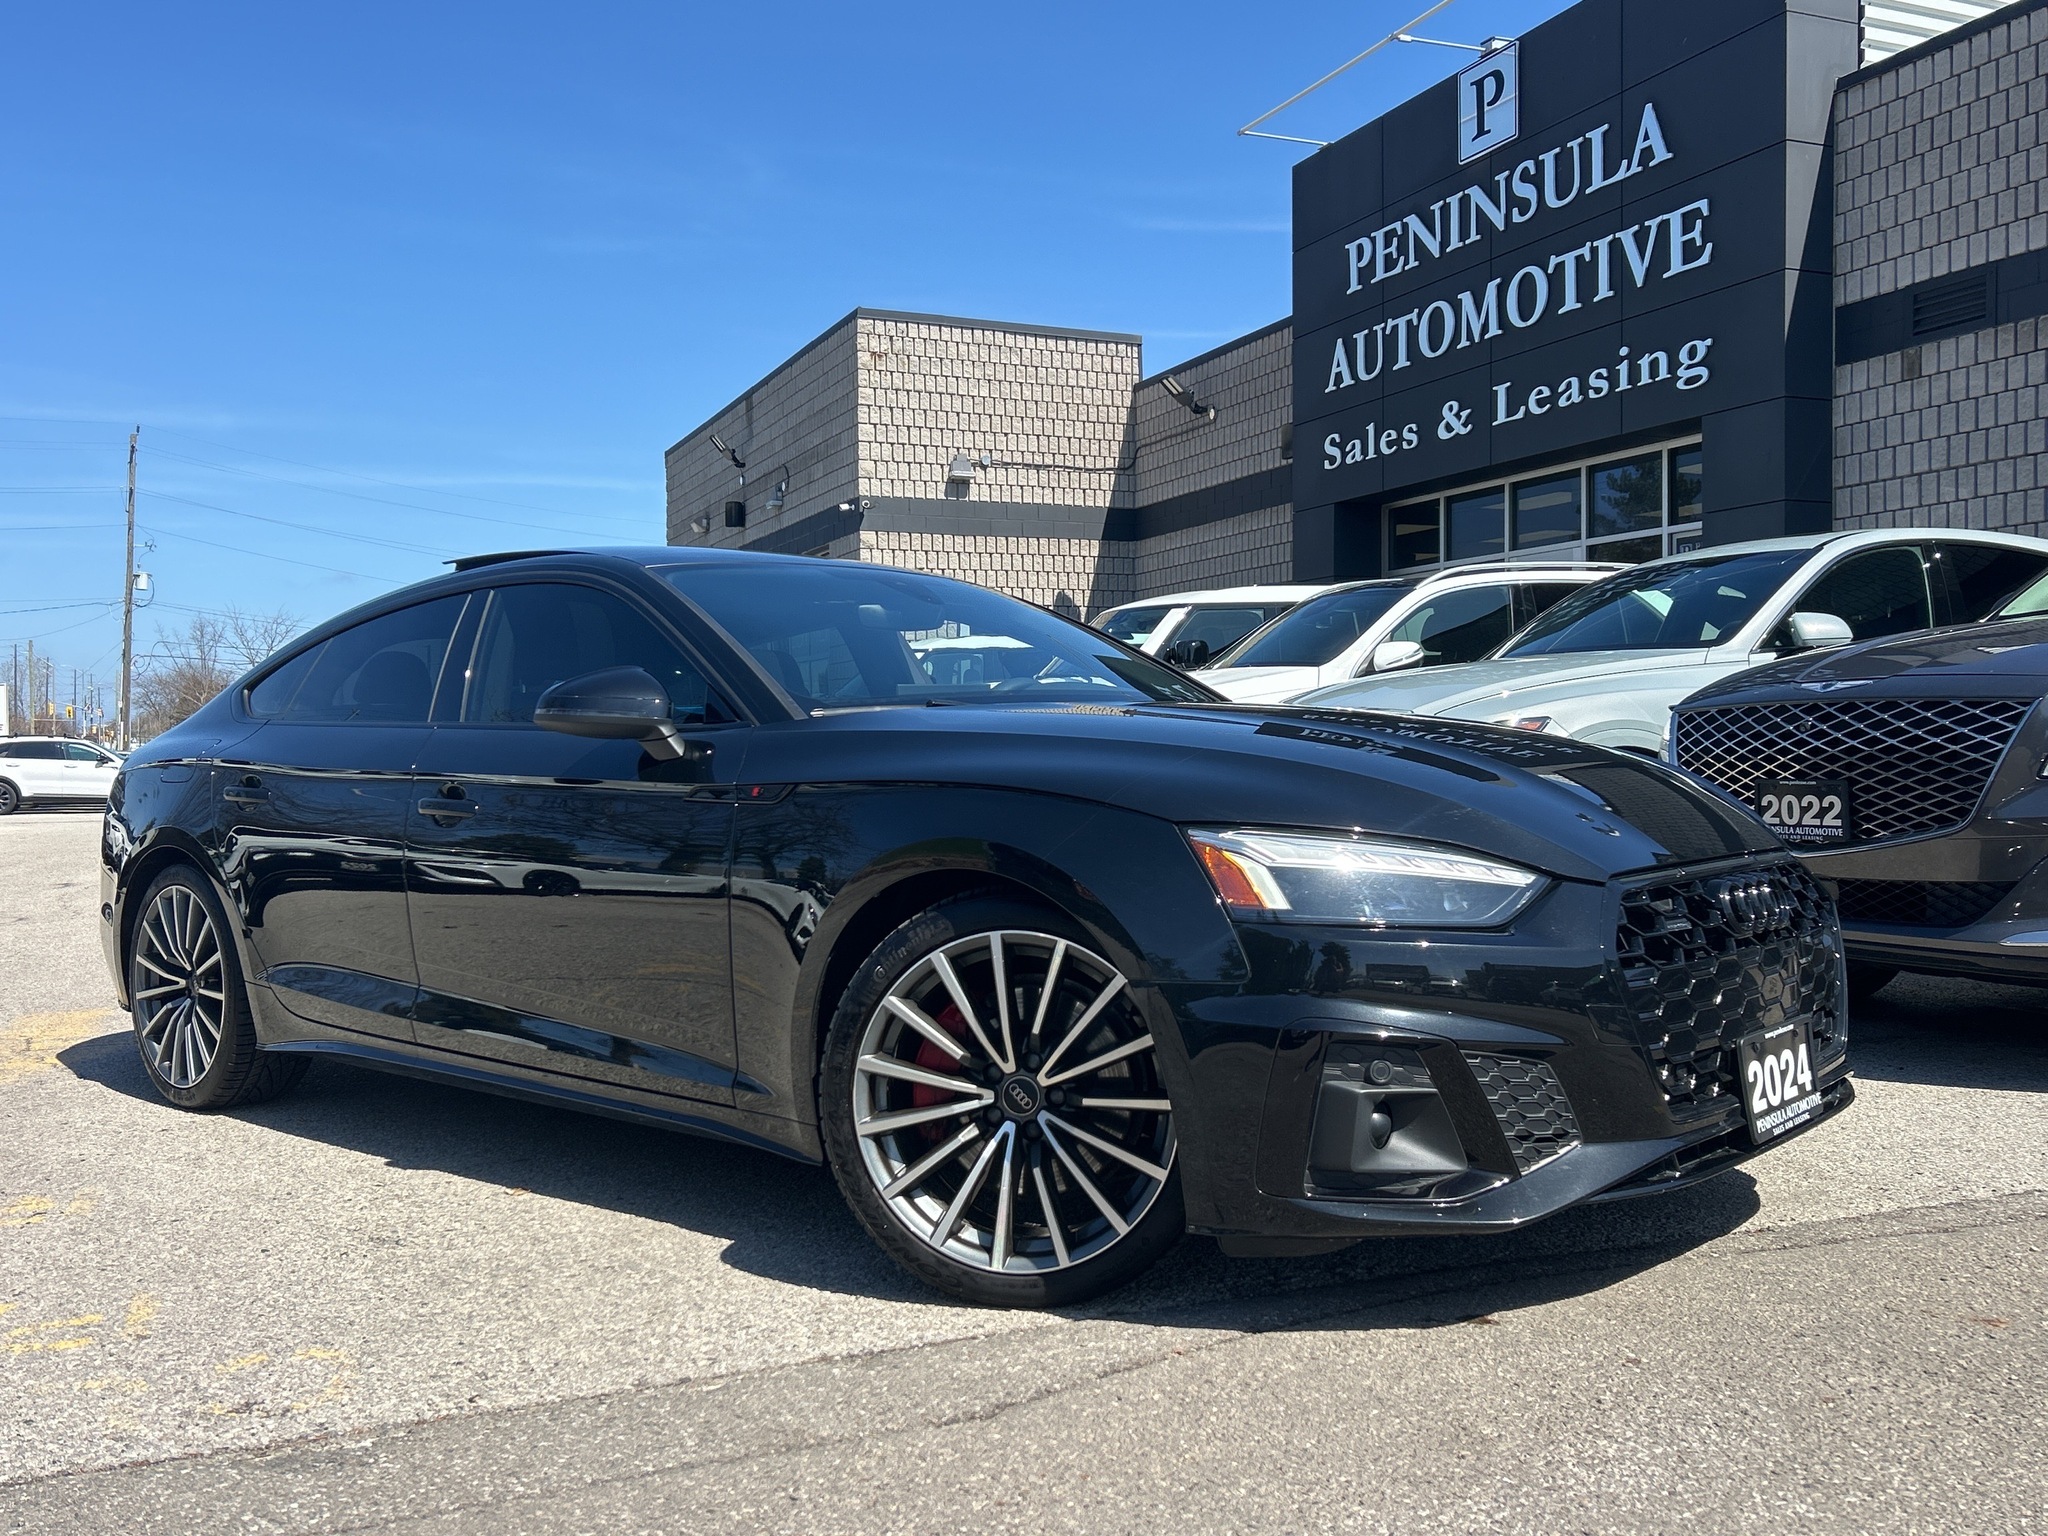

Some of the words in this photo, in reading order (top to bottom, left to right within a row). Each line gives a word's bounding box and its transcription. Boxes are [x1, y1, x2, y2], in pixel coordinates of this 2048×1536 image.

[1471, 68, 1505, 143] P
[1345, 103, 1674, 296] PENINSULA
[1324, 198, 1714, 394] AUTOMOTIVE
[1324, 422, 1419, 470] Sales
[1436, 400, 1473, 440] &
[1491, 338, 1714, 426] Leasing
[1760, 794, 1842, 826] 2022
[1794, 827, 1844, 836] AUTOMOTIVE
[1747, 1042, 1813, 1115] 2024
